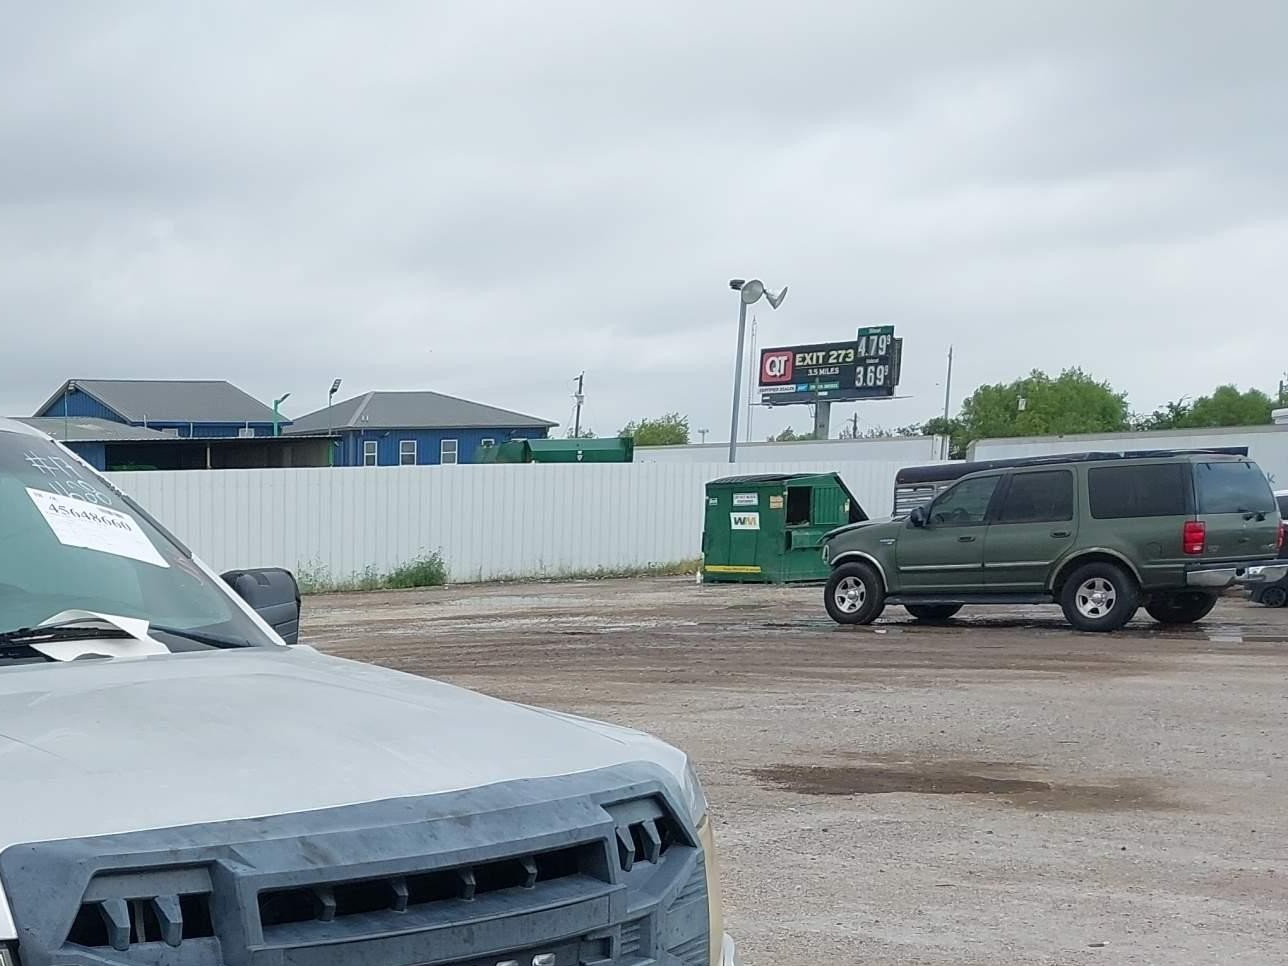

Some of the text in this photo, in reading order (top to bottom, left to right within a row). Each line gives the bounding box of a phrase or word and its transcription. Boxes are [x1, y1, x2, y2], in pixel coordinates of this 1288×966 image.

[795, 349, 855, 366] EXIT 273
[765, 356, 788, 377] QT
[819, 367, 839, 375] MILES
[733, 516, 757, 526] WM
